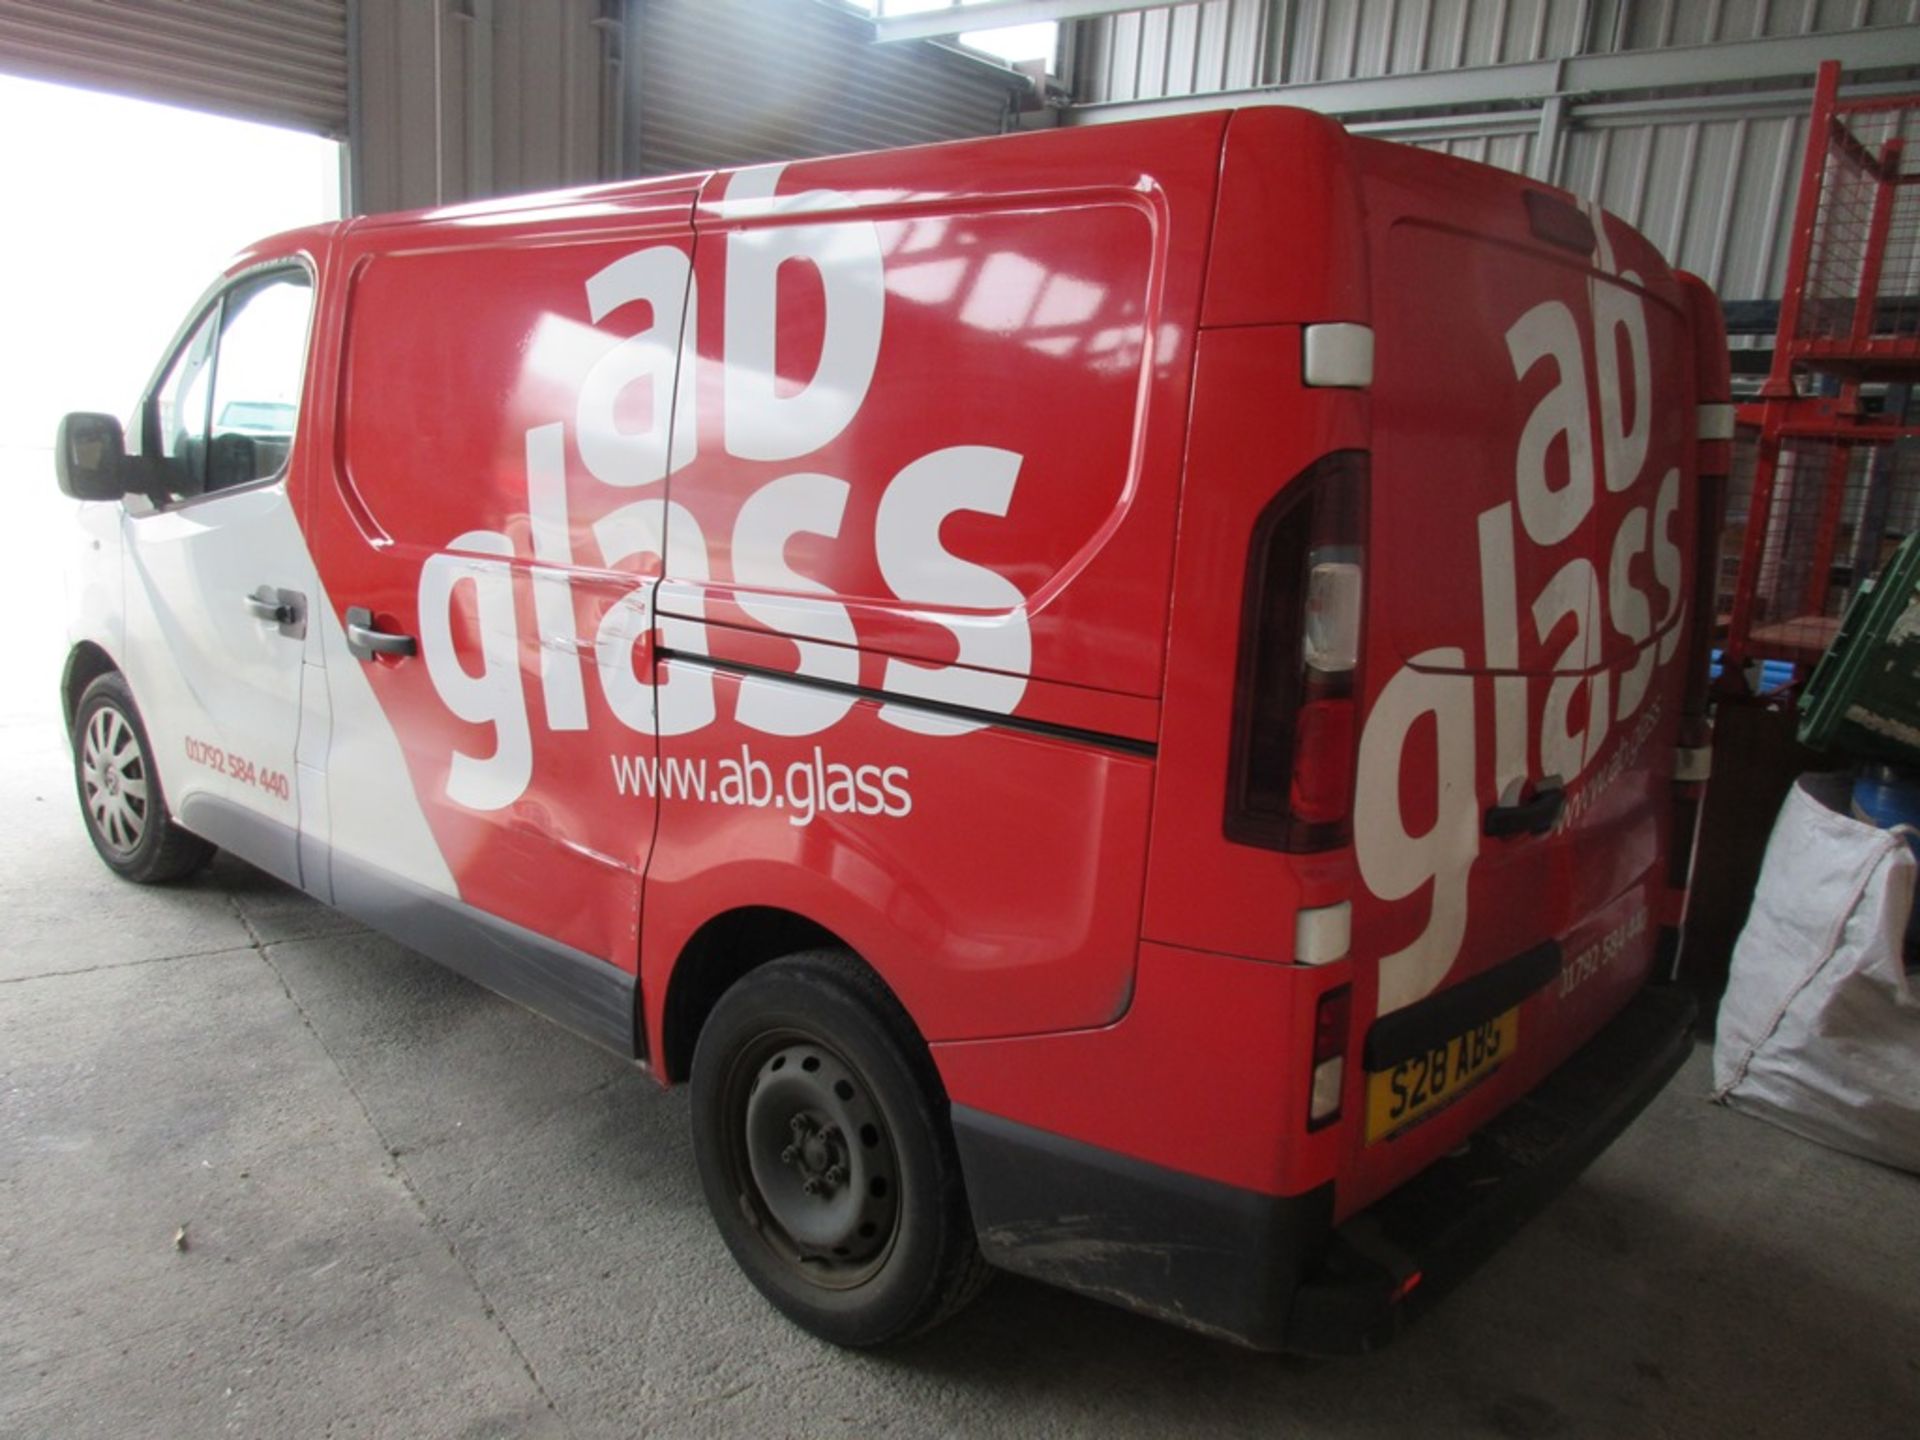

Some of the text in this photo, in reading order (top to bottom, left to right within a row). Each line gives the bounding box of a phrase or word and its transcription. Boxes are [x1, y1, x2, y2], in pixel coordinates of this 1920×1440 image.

[577, 163, 886, 488] ab
[1505, 195, 1652, 546] ab
[184, 735, 289, 801] 01792 584 440
[418, 445, 1032, 811] glass
[610, 743, 912, 826] www.ab.glass
[1354, 467, 1687, 1019] glass
[1389, 1044, 1449, 1120] S28
